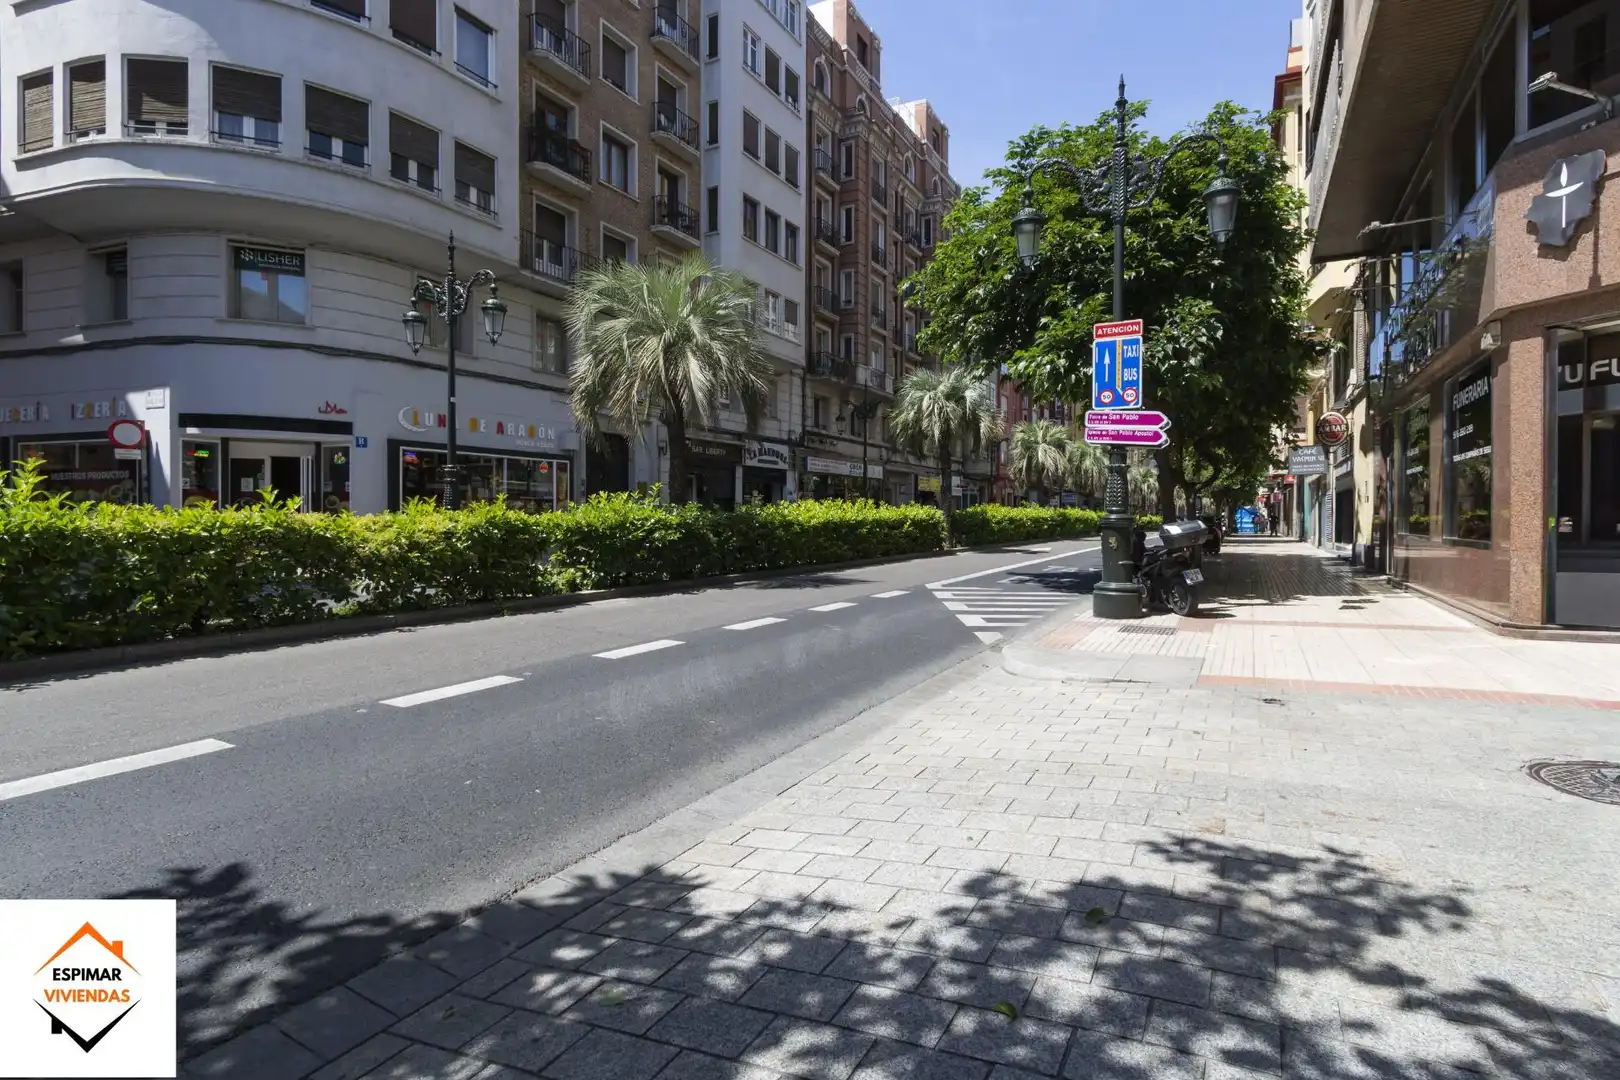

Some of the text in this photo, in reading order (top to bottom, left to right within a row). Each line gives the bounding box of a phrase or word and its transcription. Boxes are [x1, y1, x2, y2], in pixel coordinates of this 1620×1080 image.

[257, 251, 301, 266] LISHER
[1123, 345, 1139, 358] TAXI
[1123, 368, 1137, 381] BUS
[1557, 364, 1583, 383] U
[1452, 376, 1489, 411] FUNERARIA
[412, 407, 459, 430] LUN
[87, 470, 130, 480] PRODUCTOS
